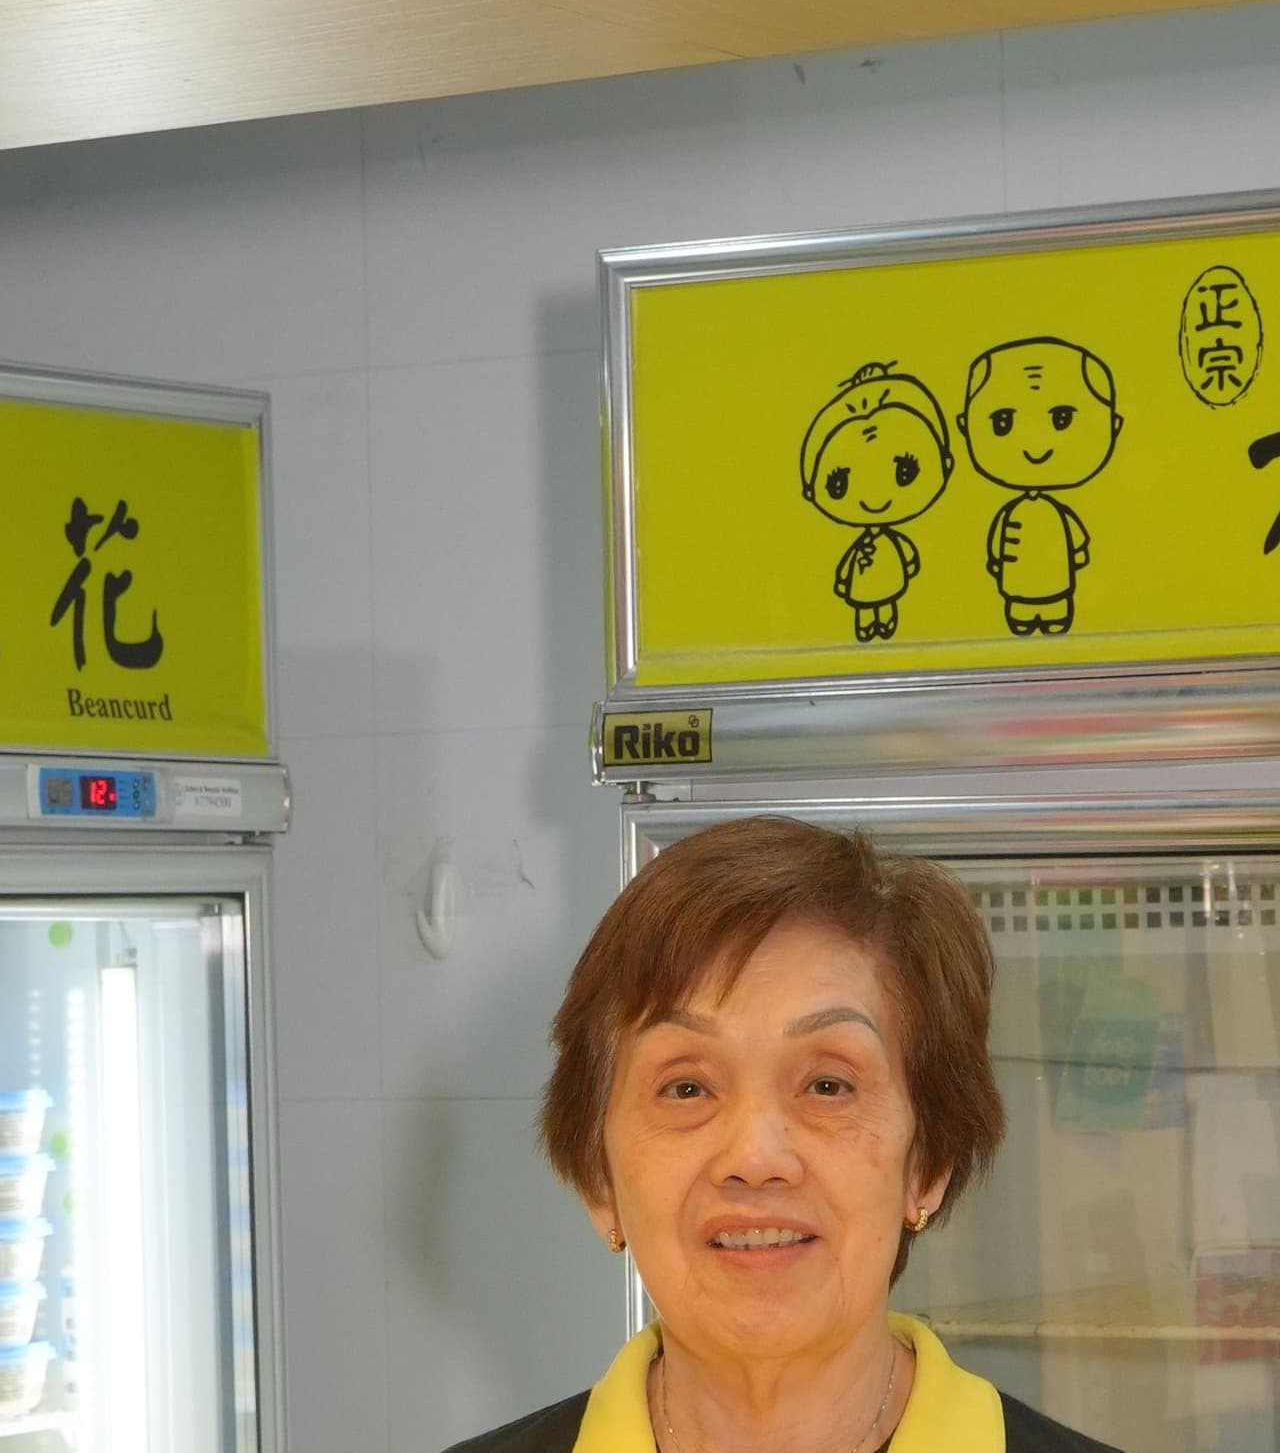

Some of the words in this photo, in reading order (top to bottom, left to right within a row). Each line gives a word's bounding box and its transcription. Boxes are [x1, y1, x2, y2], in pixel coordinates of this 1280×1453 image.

[1195, 283, 1245, 392] 正宗
[67, 688, 174, 722] Beancurd
[614, 722, 701, 759] Riko
